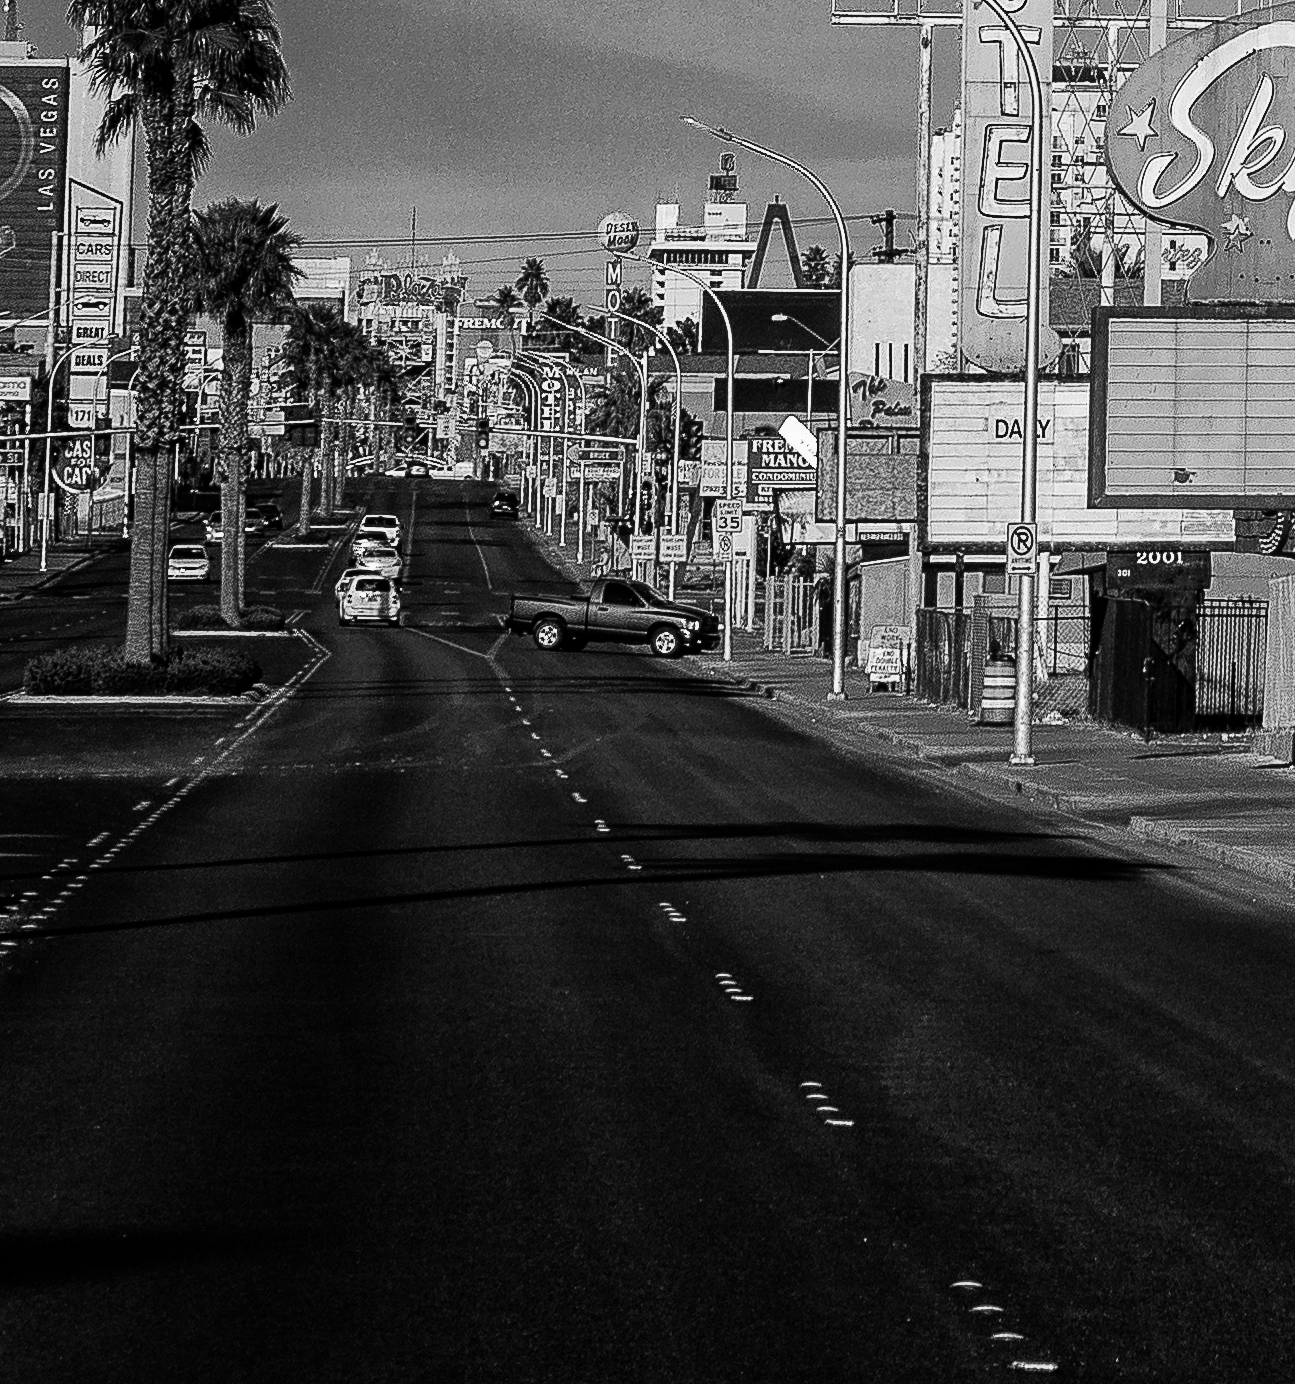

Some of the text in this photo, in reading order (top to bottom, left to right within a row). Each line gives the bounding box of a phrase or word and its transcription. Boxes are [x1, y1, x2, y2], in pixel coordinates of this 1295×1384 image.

[37, 77, 60, 212] LAS VEGAS
[76, 242, 112, 256] CARS
[75, 270, 110, 284] DIRECT
[76, 326, 105, 339] GREAT
[74, 353, 104, 367] DEALS
[995, 418, 1051, 439] DAY
[64, 439, 92, 458] CAS
[761, 453, 811, 468] MANO
[718, 516, 740, 530] 35
[1136, 551, 1184, 565] 2001
